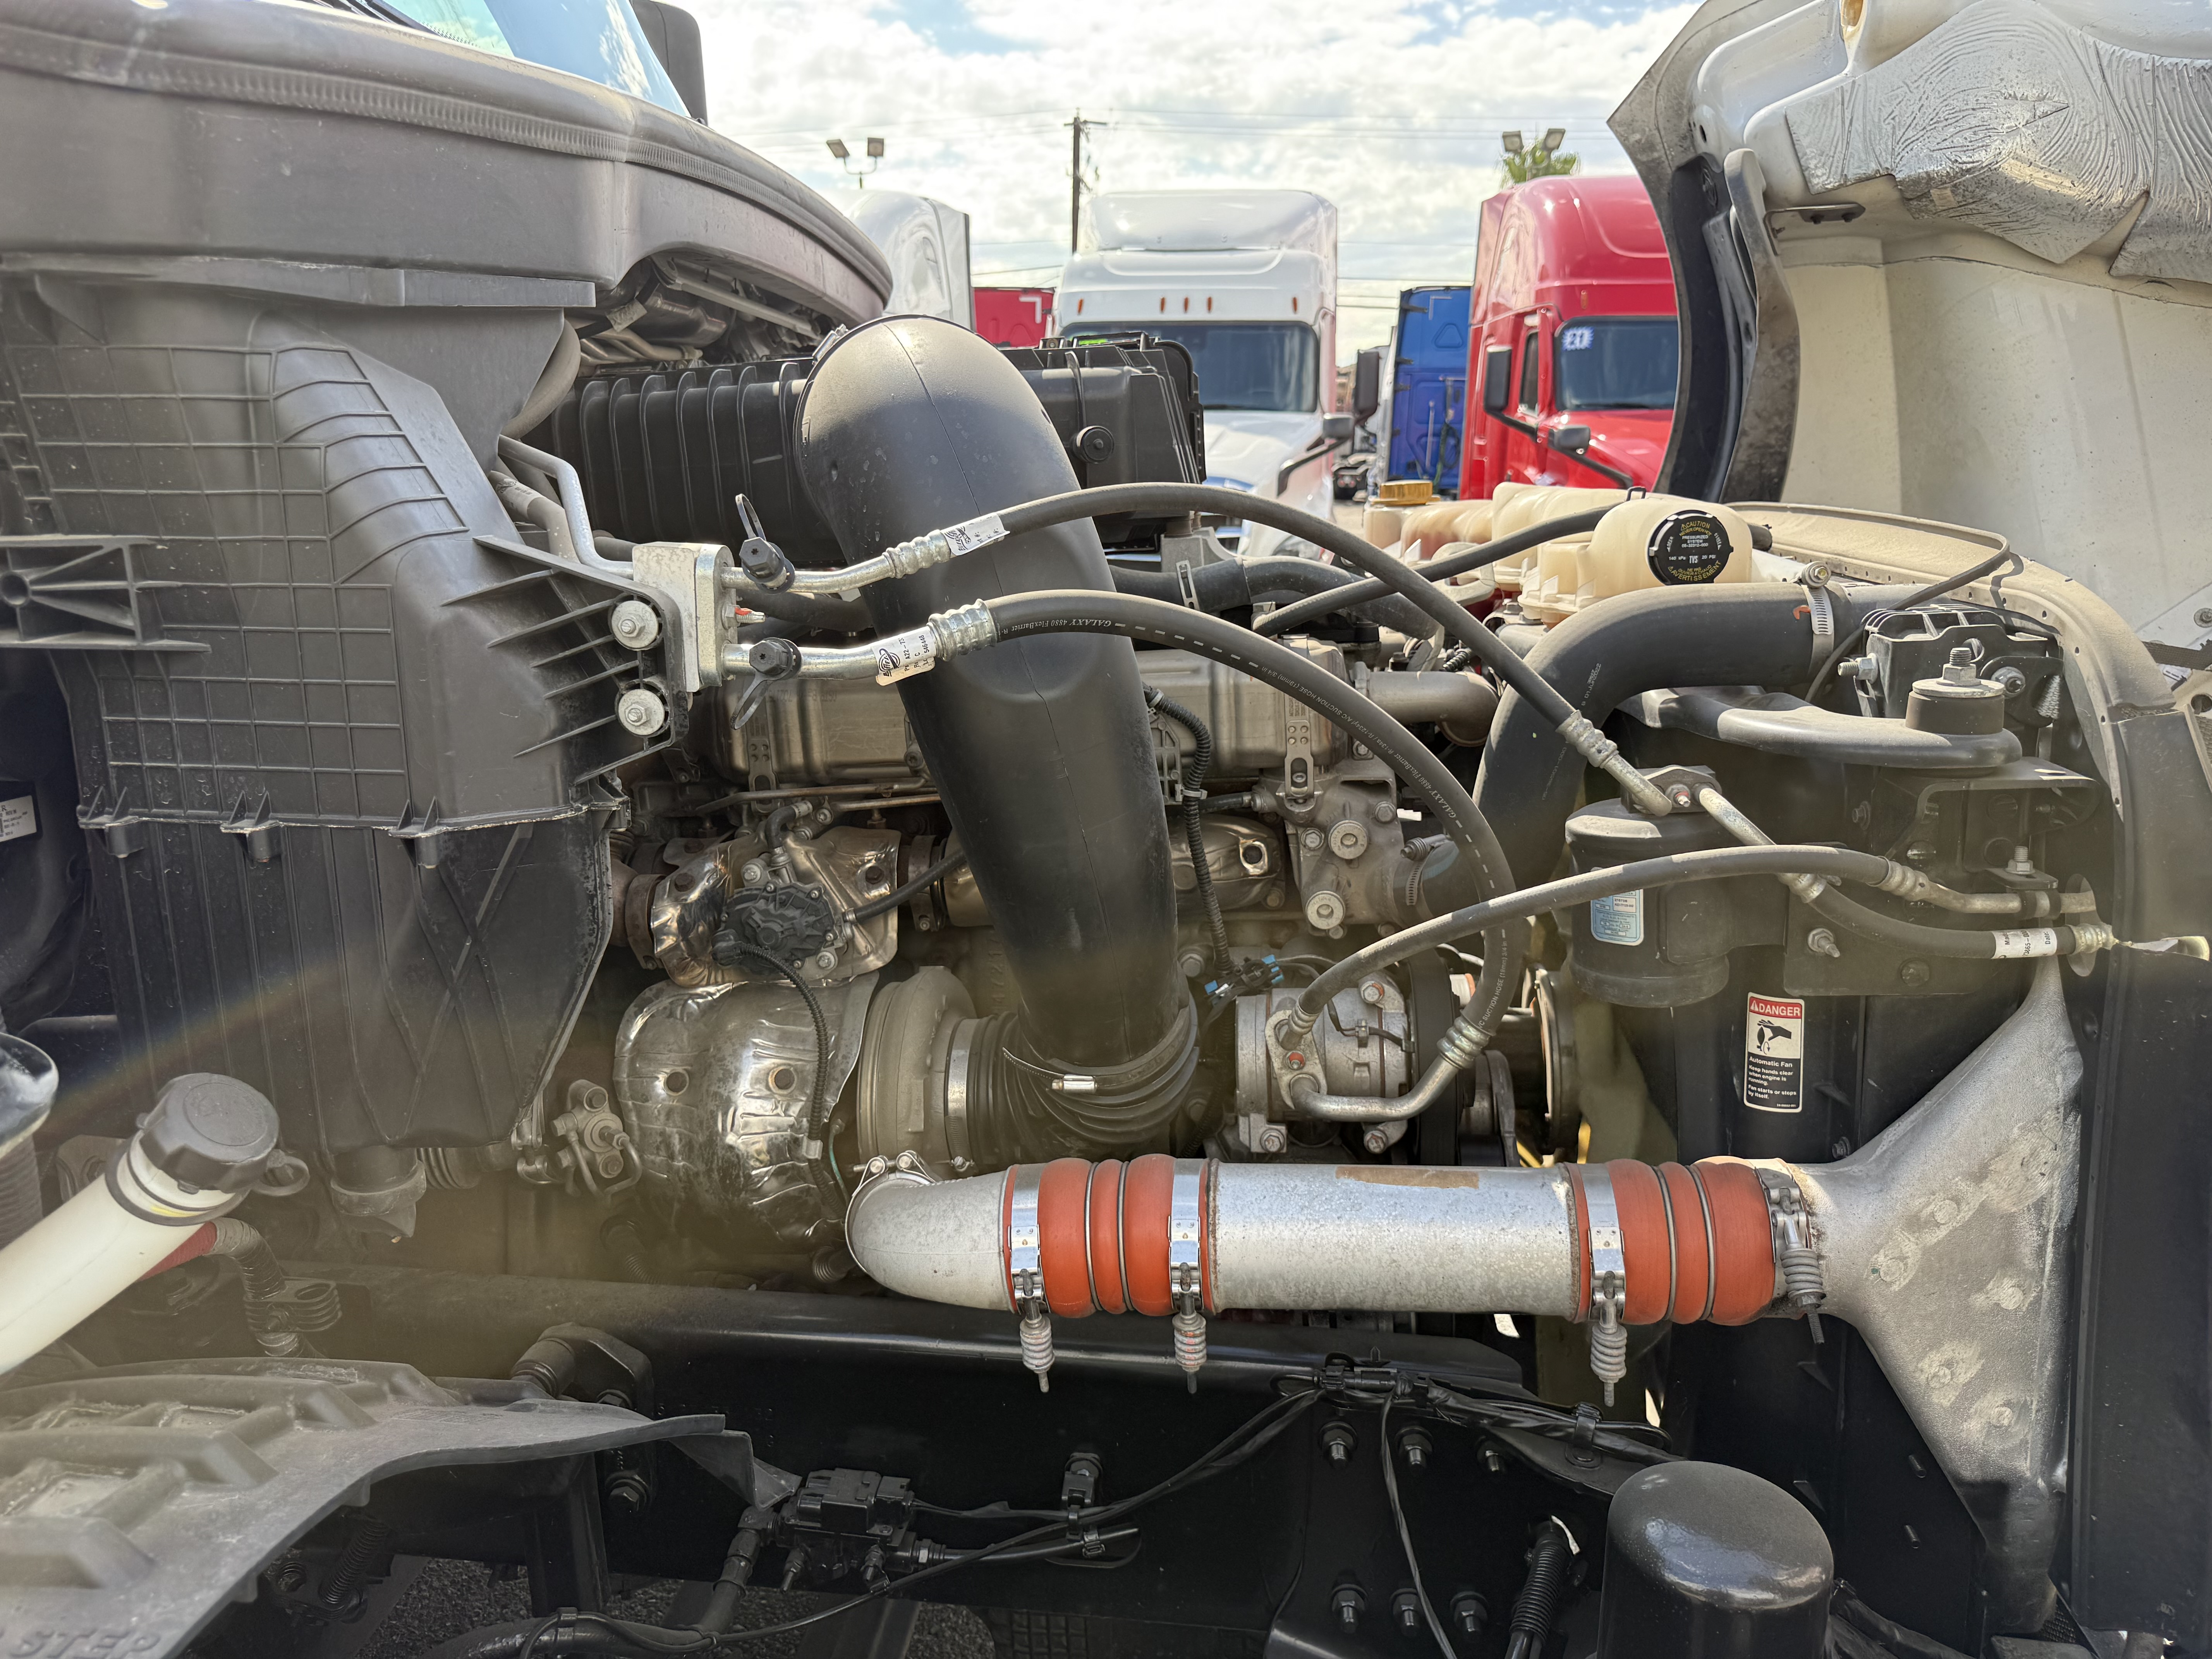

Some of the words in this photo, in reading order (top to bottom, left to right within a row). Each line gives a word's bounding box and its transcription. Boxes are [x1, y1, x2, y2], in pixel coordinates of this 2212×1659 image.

[1679, 528, 1693, 536] NEVER
[1671, 560, 1721, 581] AVERTISSEMENT
[1697, 565, 1712, 575] CHAUD
[1011, 620, 1049, 632] FlexBarrier
[1069, 619, 1111, 627] GALAXY
[919, 635, 930, 653] 546448
[1278, 674, 1300, 688] (19mm)
[1299, 686, 1317, 699] HOSE
[1316, 697, 1342, 715] SUCTION
[1341, 714, 1352, 722] A/C
[1351, 721, 1374, 738] R-1234yf
[1377, 739, 1394, 755] R-134a
[1394, 753, 1421, 779] FlexBarrier
[1418, 777, 1431, 790] 4880
[1429, 790, 1457, 818] GALAXY
[1482, 995, 1499, 1021] SUCTION
[1759, 1003, 1800, 1017] DANGER
[1749, 1056, 1779, 1066] Automatic
[1748, 1077, 1768, 1085] running.
